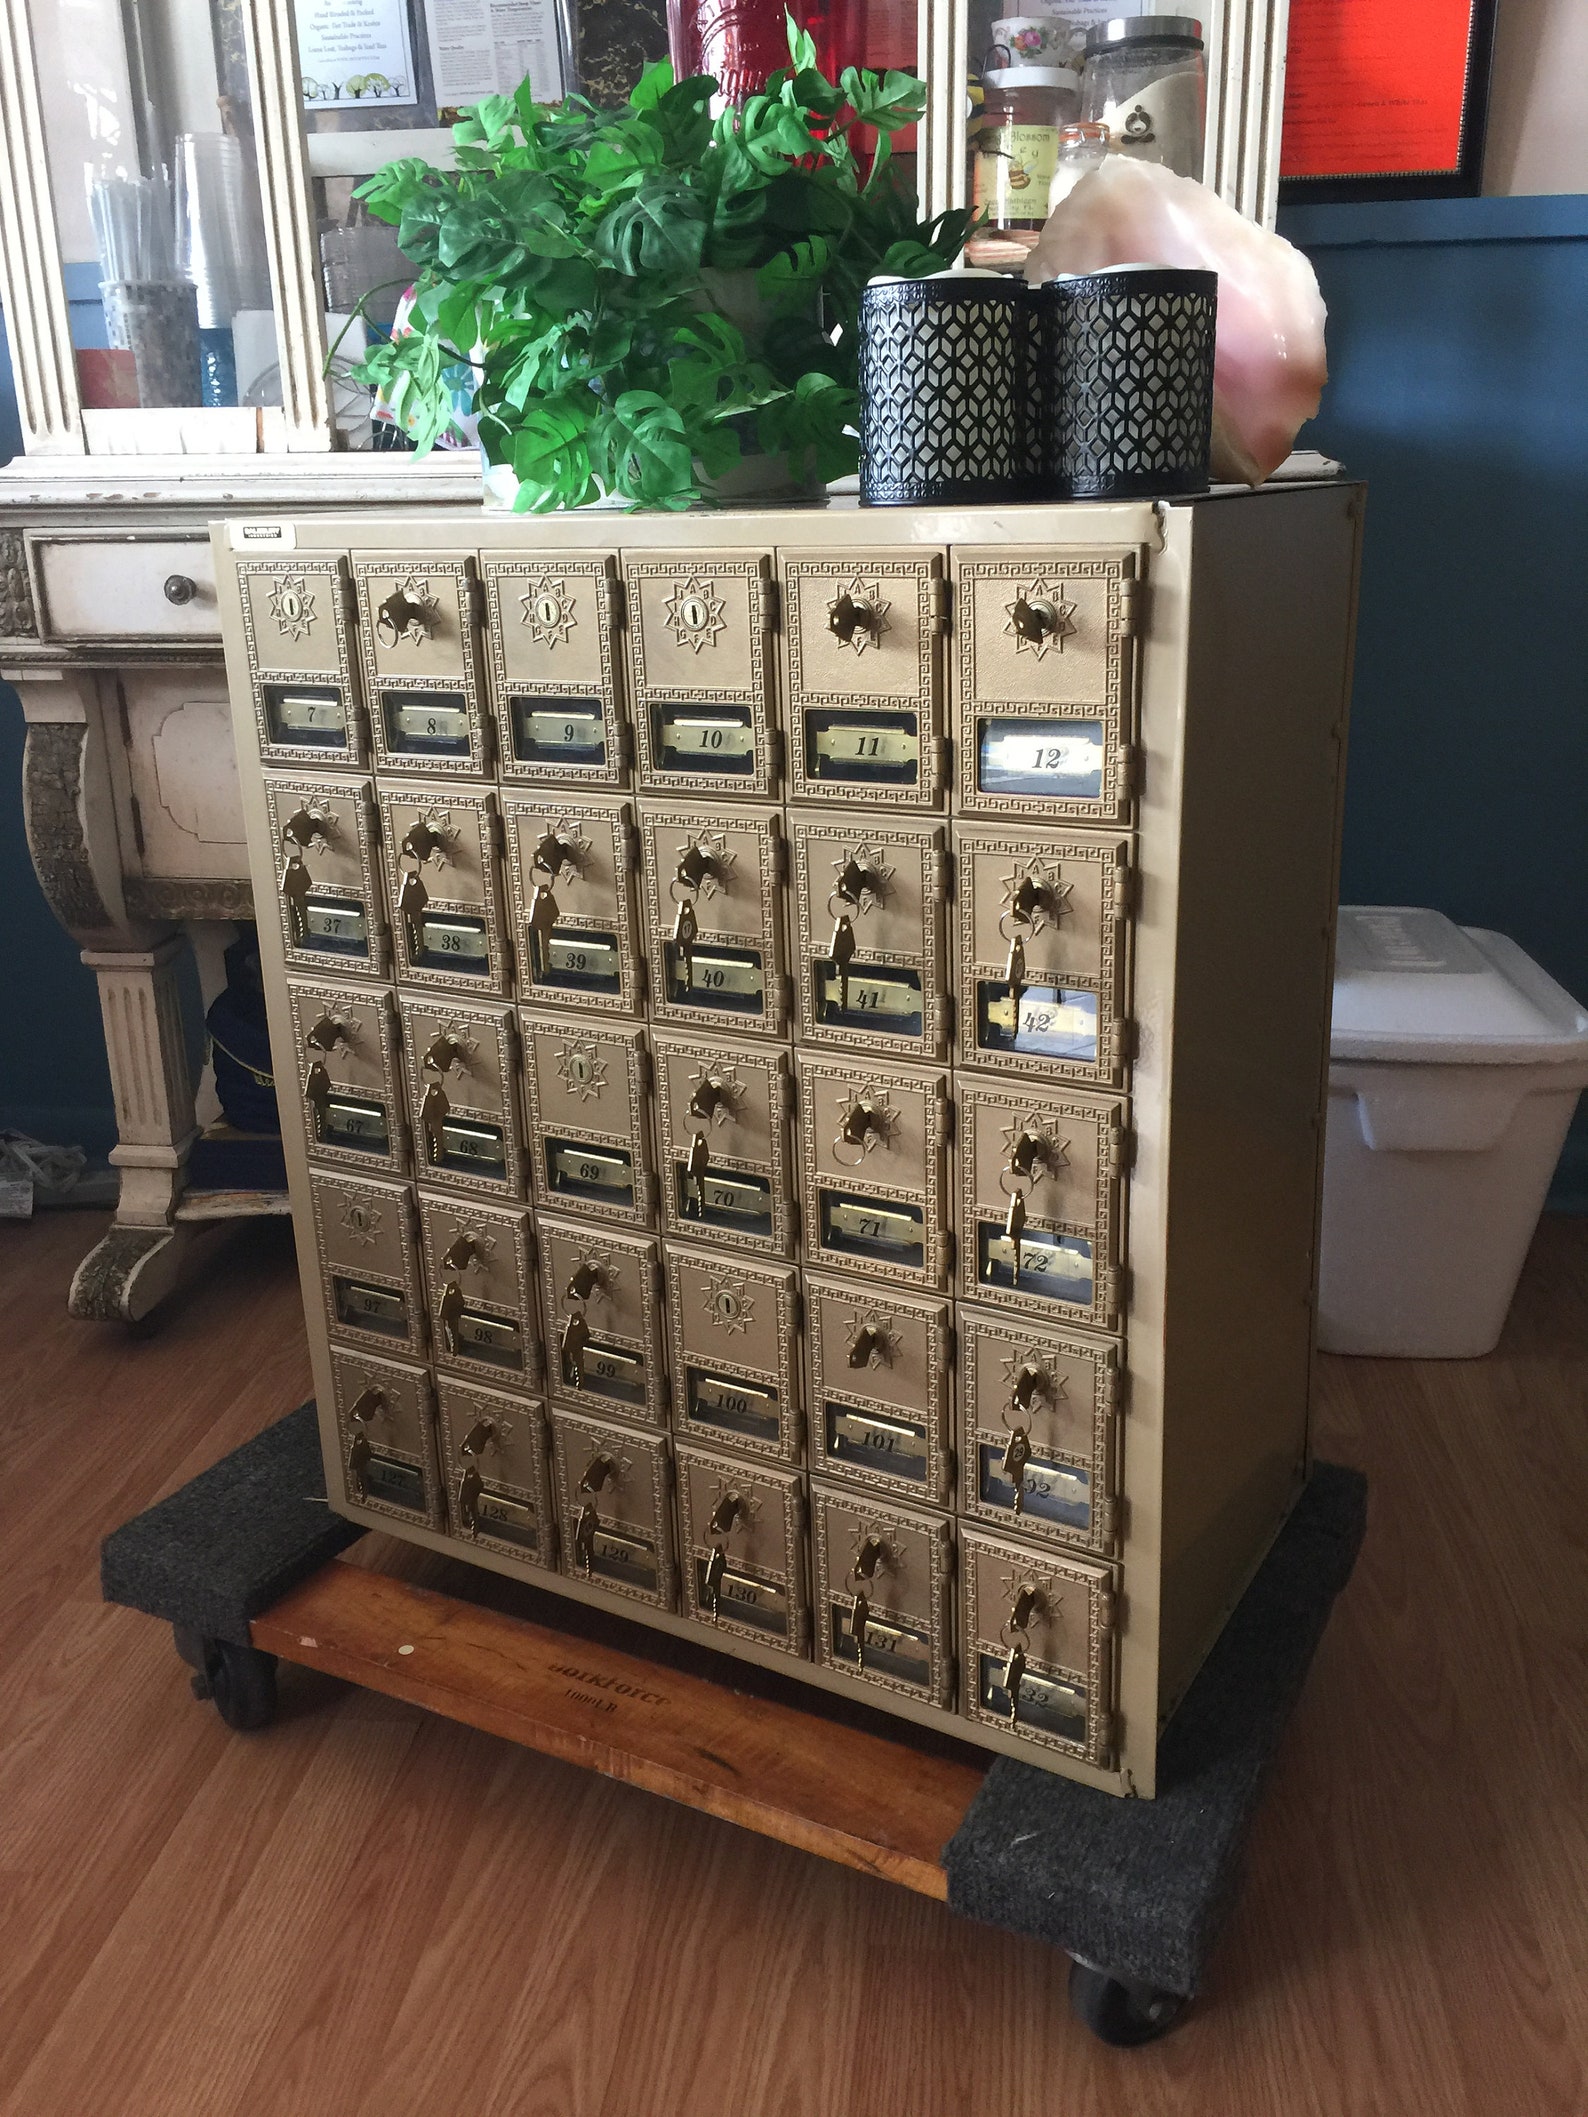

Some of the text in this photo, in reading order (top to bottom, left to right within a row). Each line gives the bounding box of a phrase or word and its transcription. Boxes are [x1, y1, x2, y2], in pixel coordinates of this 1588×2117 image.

[307, 706, 316, 722] 7
[427, 717, 437, 735] 8
[564, 724, 574, 741] 9
[698, 729, 723, 748] 10
[855, 737, 880, 757] 11
[1032, 748, 1061, 769] 12
[323, 917, 342, 934] 37
[441, 934, 461, 951] 38
[565, 952, 586, 970] 39
[702, 968, 725, 988] 40
[856, 990, 879, 1009] 41
[1022, 1012, 1051, 1033] 42
[346, 1118, 364, 1133] 67
[460, 1140, 479, 1156] 68
[579, 1162, 600, 1180] 69
[713, 1189, 735, 1207] 70
[859, 1218, 881, 1238] 71
[1023, 1252, 1049, 1272] 72
[473, 1327, 493, 1344] 98
[596, 1360, 616, 1378] 99
[716, 1393, 748, 1414] 100
[861, 1431, 895, 1452] 101
[1023, 1478, 1051, 1499] 02
[482, 1504, 508, 1521] 128
[601, 1544, 629, 1563] 129
[727, 1585, 757, 1605] 130
[864, 1632, 897, 1654] 131
[1021, 1687, 1049, 1707] 32
